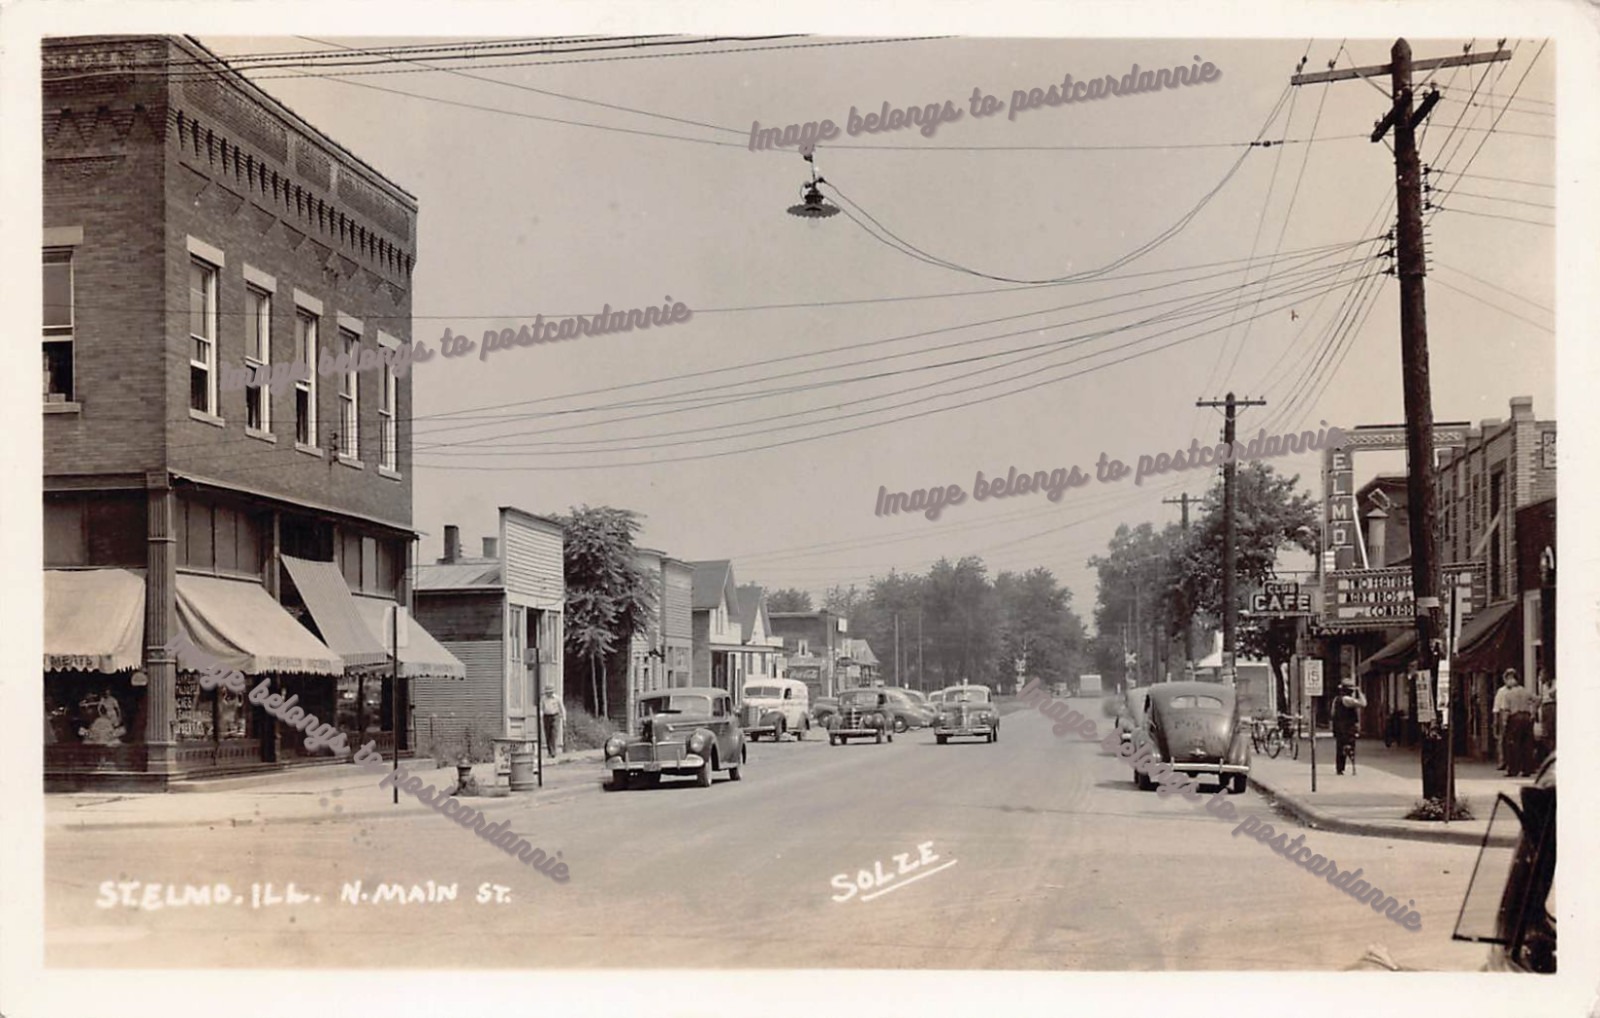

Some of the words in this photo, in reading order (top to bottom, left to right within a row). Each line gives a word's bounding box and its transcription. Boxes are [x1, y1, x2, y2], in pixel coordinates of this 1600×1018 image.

[1332, 453, 1347, 545] ELMO
[1266, 583, 1296, 594] CLUB
[1254, 595, 1309, 611] CAFE
[50, 655, 94, 667] MEATS
